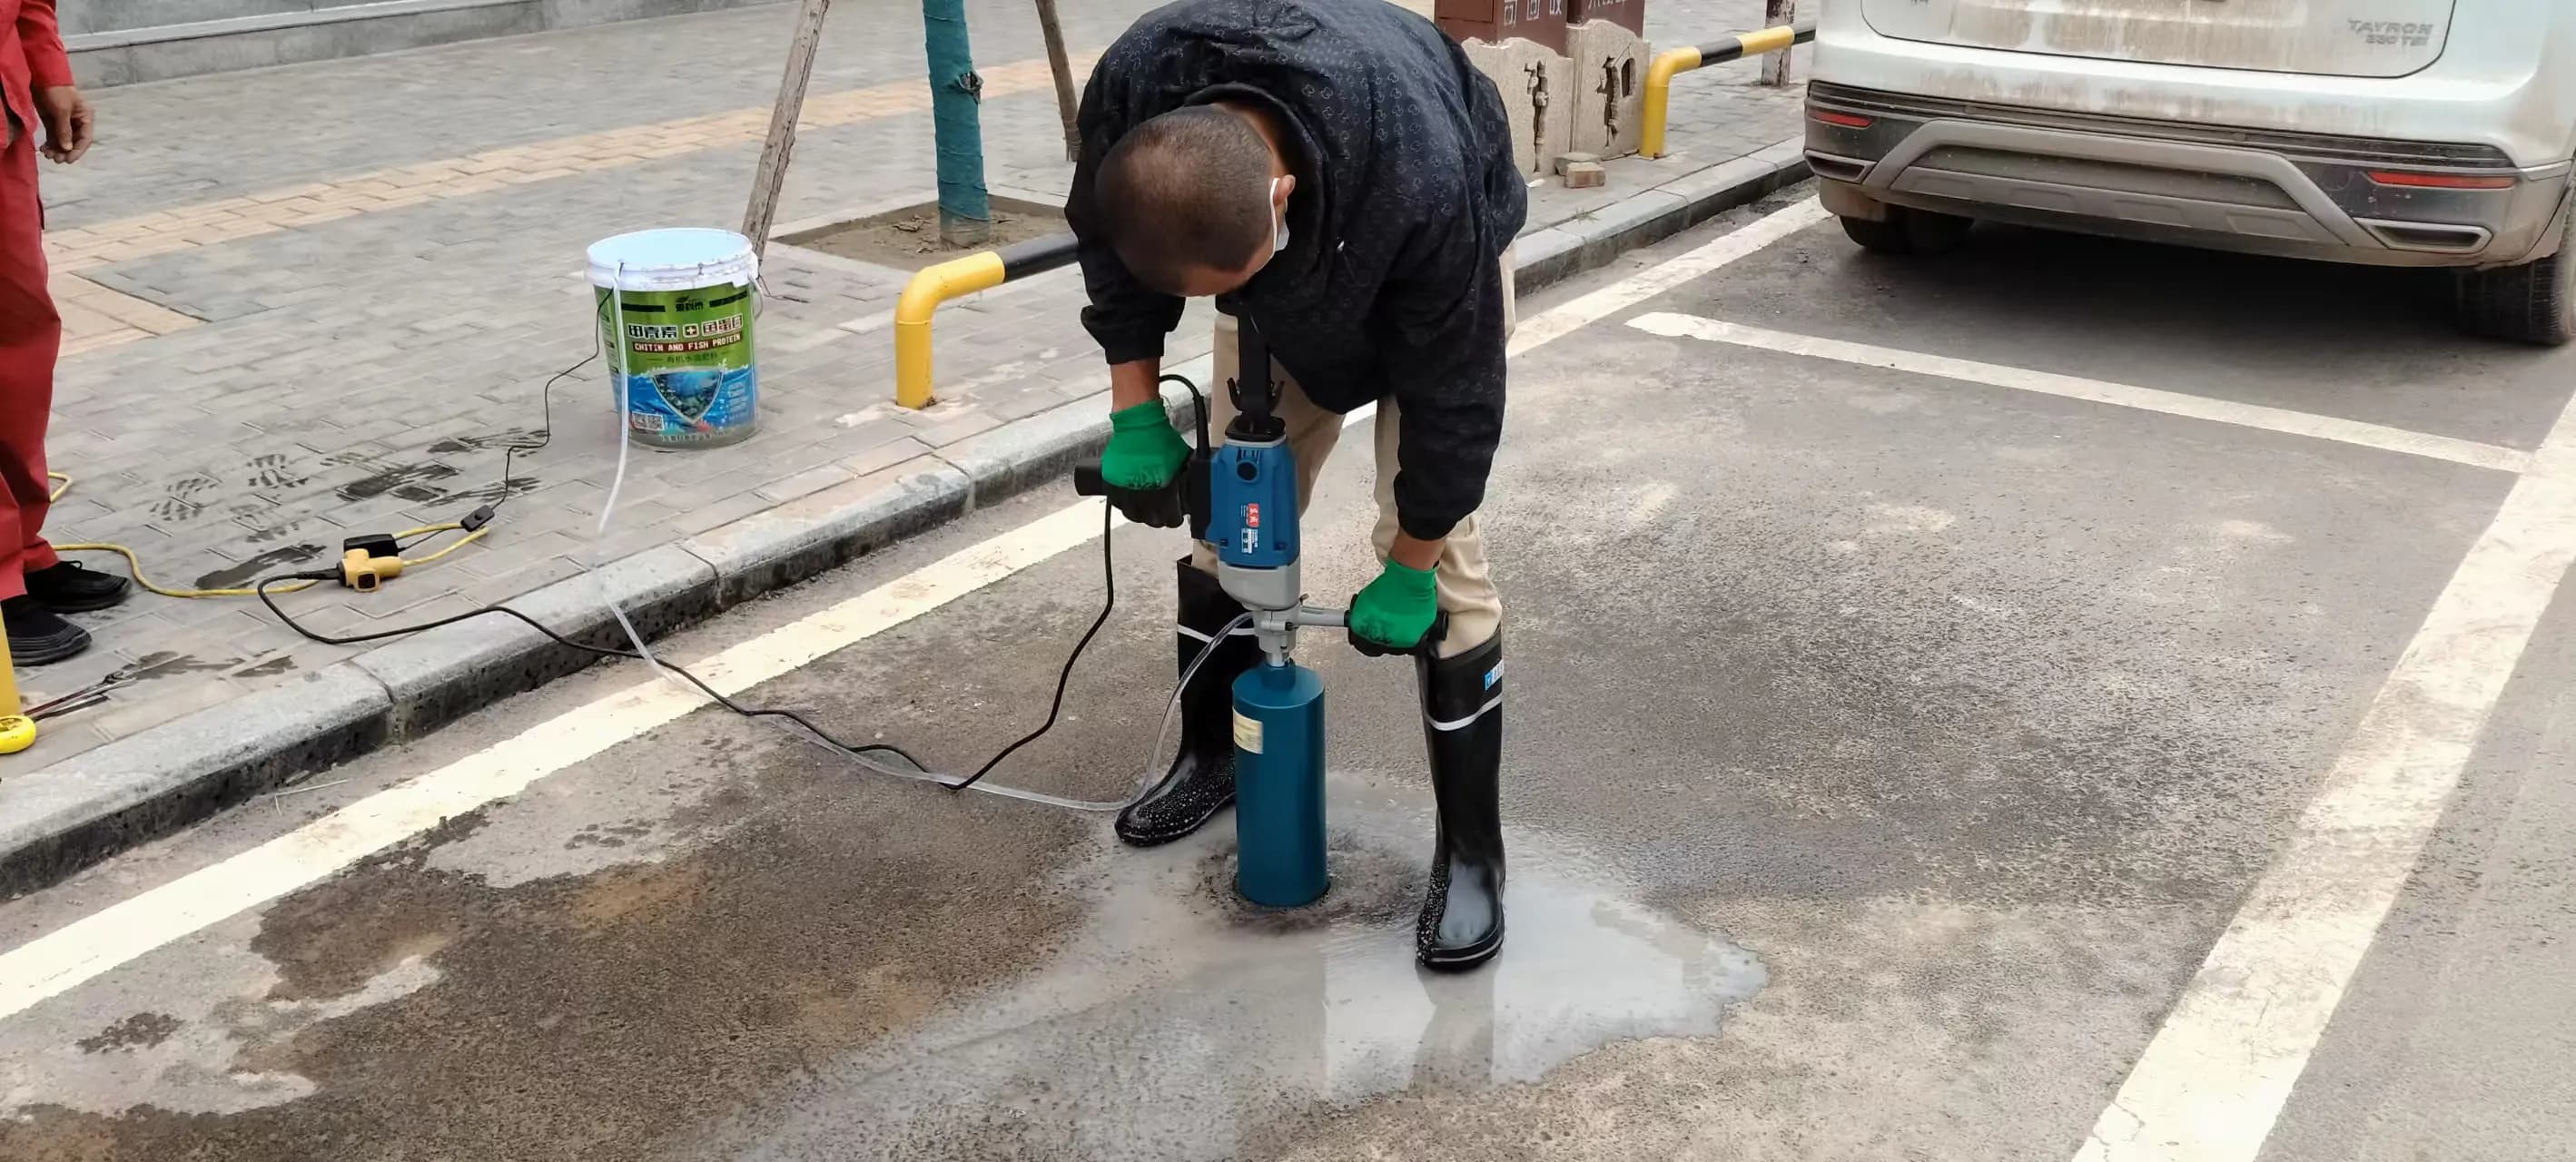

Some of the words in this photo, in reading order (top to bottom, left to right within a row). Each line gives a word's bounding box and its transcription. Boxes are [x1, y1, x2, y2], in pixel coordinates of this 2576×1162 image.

[2348, 20, 2433, 36] TAYRON
[635, 342, 664, 352] CHITIN
[667, 343, 684, 352] AND
[688, 340, 709, 350] FISH
[712, 333, 741, 347] PROTEIN
